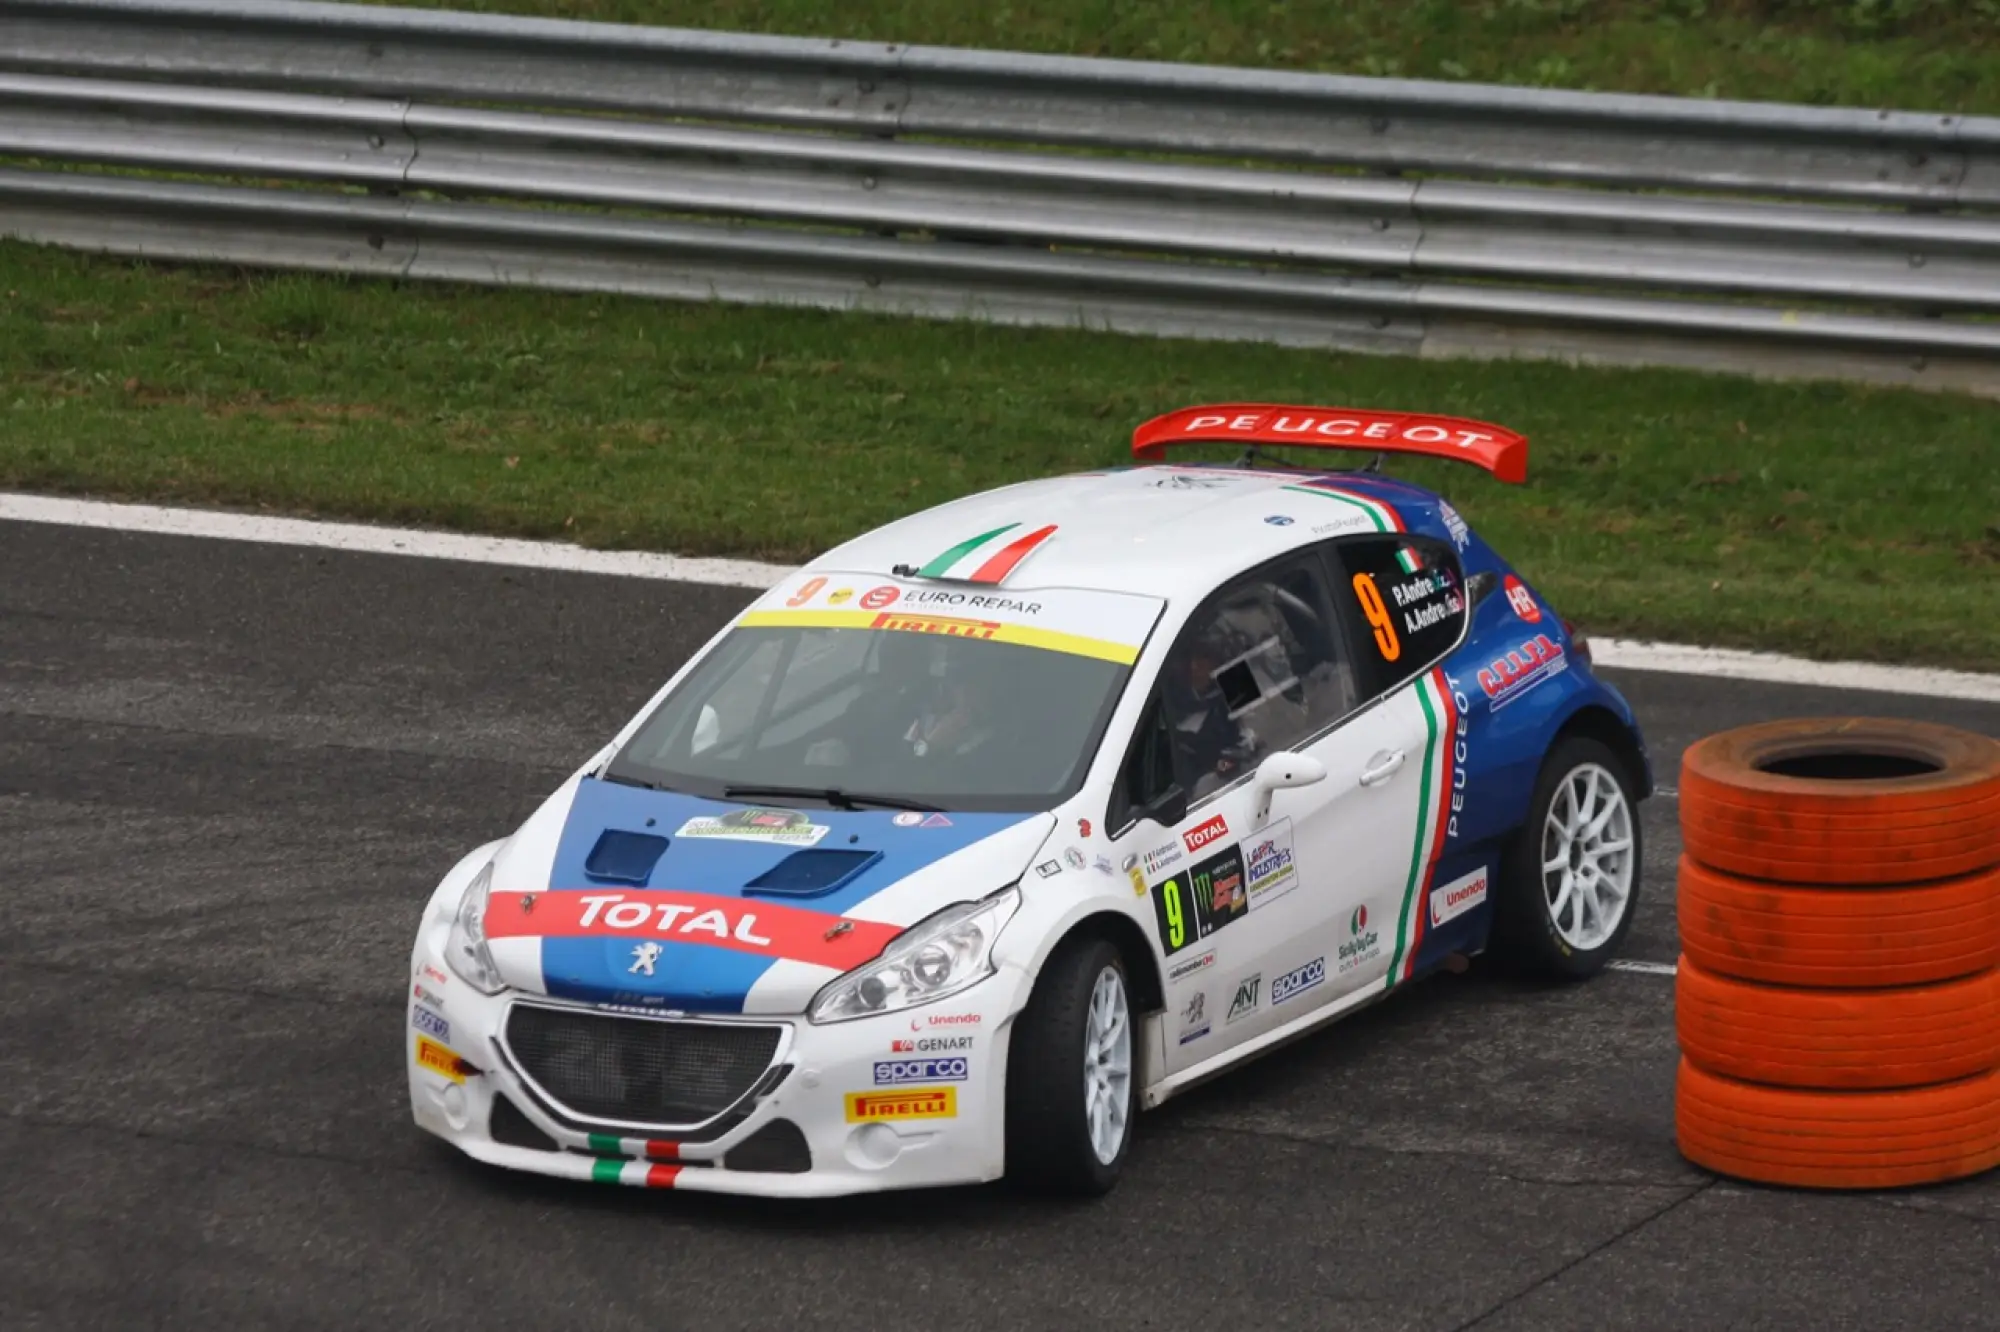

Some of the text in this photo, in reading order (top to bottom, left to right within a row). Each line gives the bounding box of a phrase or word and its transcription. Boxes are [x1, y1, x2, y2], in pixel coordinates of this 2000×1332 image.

[1185, 415, 1493, 449] PEUGEOT
[785, 576, 829, 607] 9
[903, 589, 1043, 615] EURO REPAR
[867, 612, 1002, 640] PIRELLI
[1352, 572, 1401, 663] 9
[1446, 670, 1470, 838] PEUGEOT
[1185, 821, 1226, 849] TOTAL
[1446, 878, 1485, 906] Unendo
[578, 893, 772, 947] TOTAL
[1163, 879, 1185, 949] 9
[1273, 960, 1324, 1000] sparco
[1227, 977, 1262, 1019] ANT
[928, 1013, 981, 1026] Unendo
[917, 1036, 974, 1052] GENART
[875, 1059, 967, 1084] sparco
[854, 1091, 947, 1118] PIRELLI
